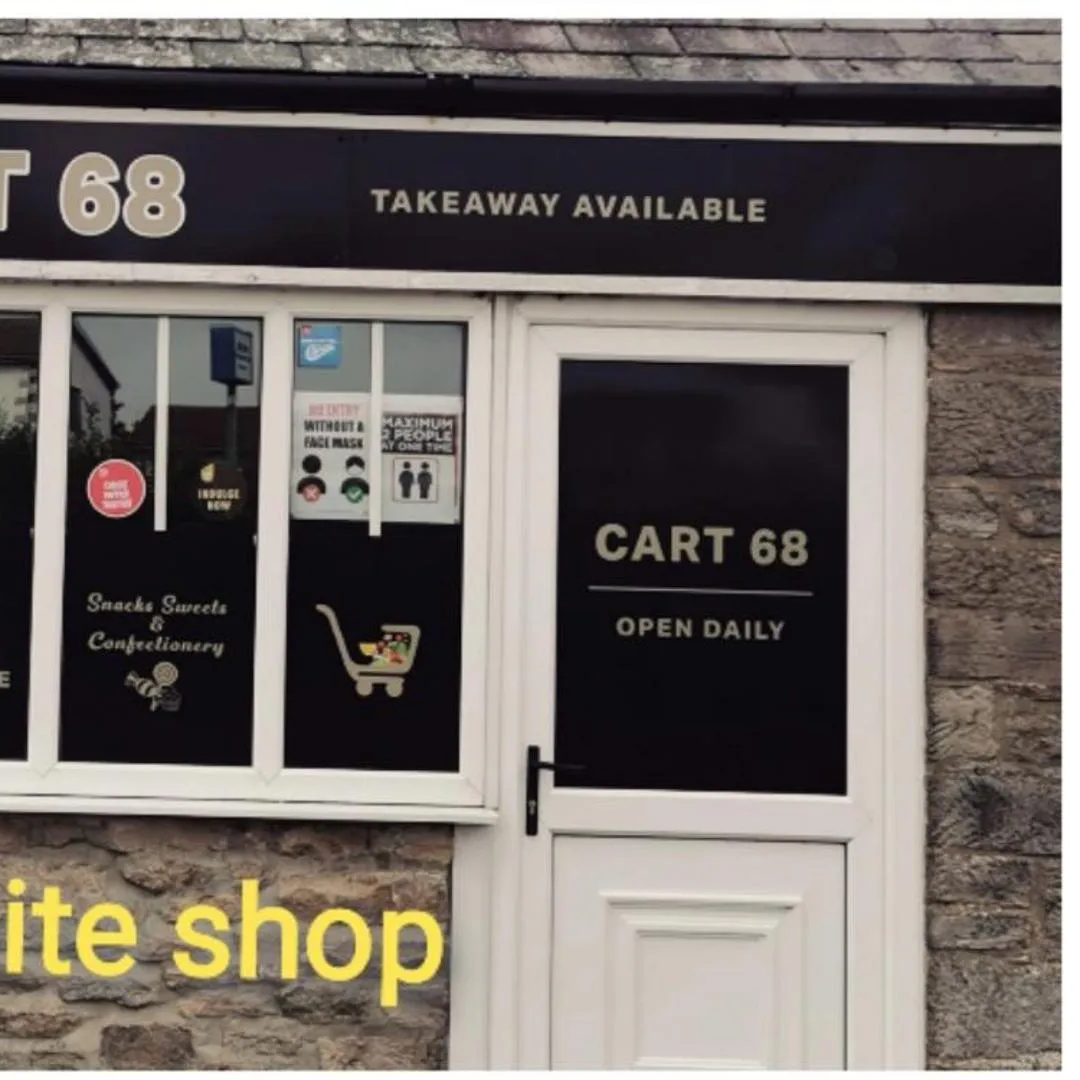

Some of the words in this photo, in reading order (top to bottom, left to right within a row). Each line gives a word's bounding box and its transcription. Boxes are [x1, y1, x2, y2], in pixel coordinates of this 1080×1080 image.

[57, 151, 187, 239] 68
[370, 188, 561, 218] TAKEAWAY
[573, 194, 767, 223] AVAILABLE
[304, 419, 355, 433] WITHOUT
[357, 420, 365, 433] A
[381, 415, 453, 429] MAXIMUM
[304, 436, 330, 449] FACE
[332, 437, 364, 449] MASK
[394, 428, 453, 441] PEOPLE
[595, 522, 735, 564] CART
[750, 528, 809, 567] 68
[86, 592, 153, 613] Snacks
[161, 594, 228, 615] Sweets
[149, 615, 166, 632] &
[616, 616, 693, 638] OPEN
[703, 620, 785, 641] DAILY
[88, 631, 225, 658] Confectionery
